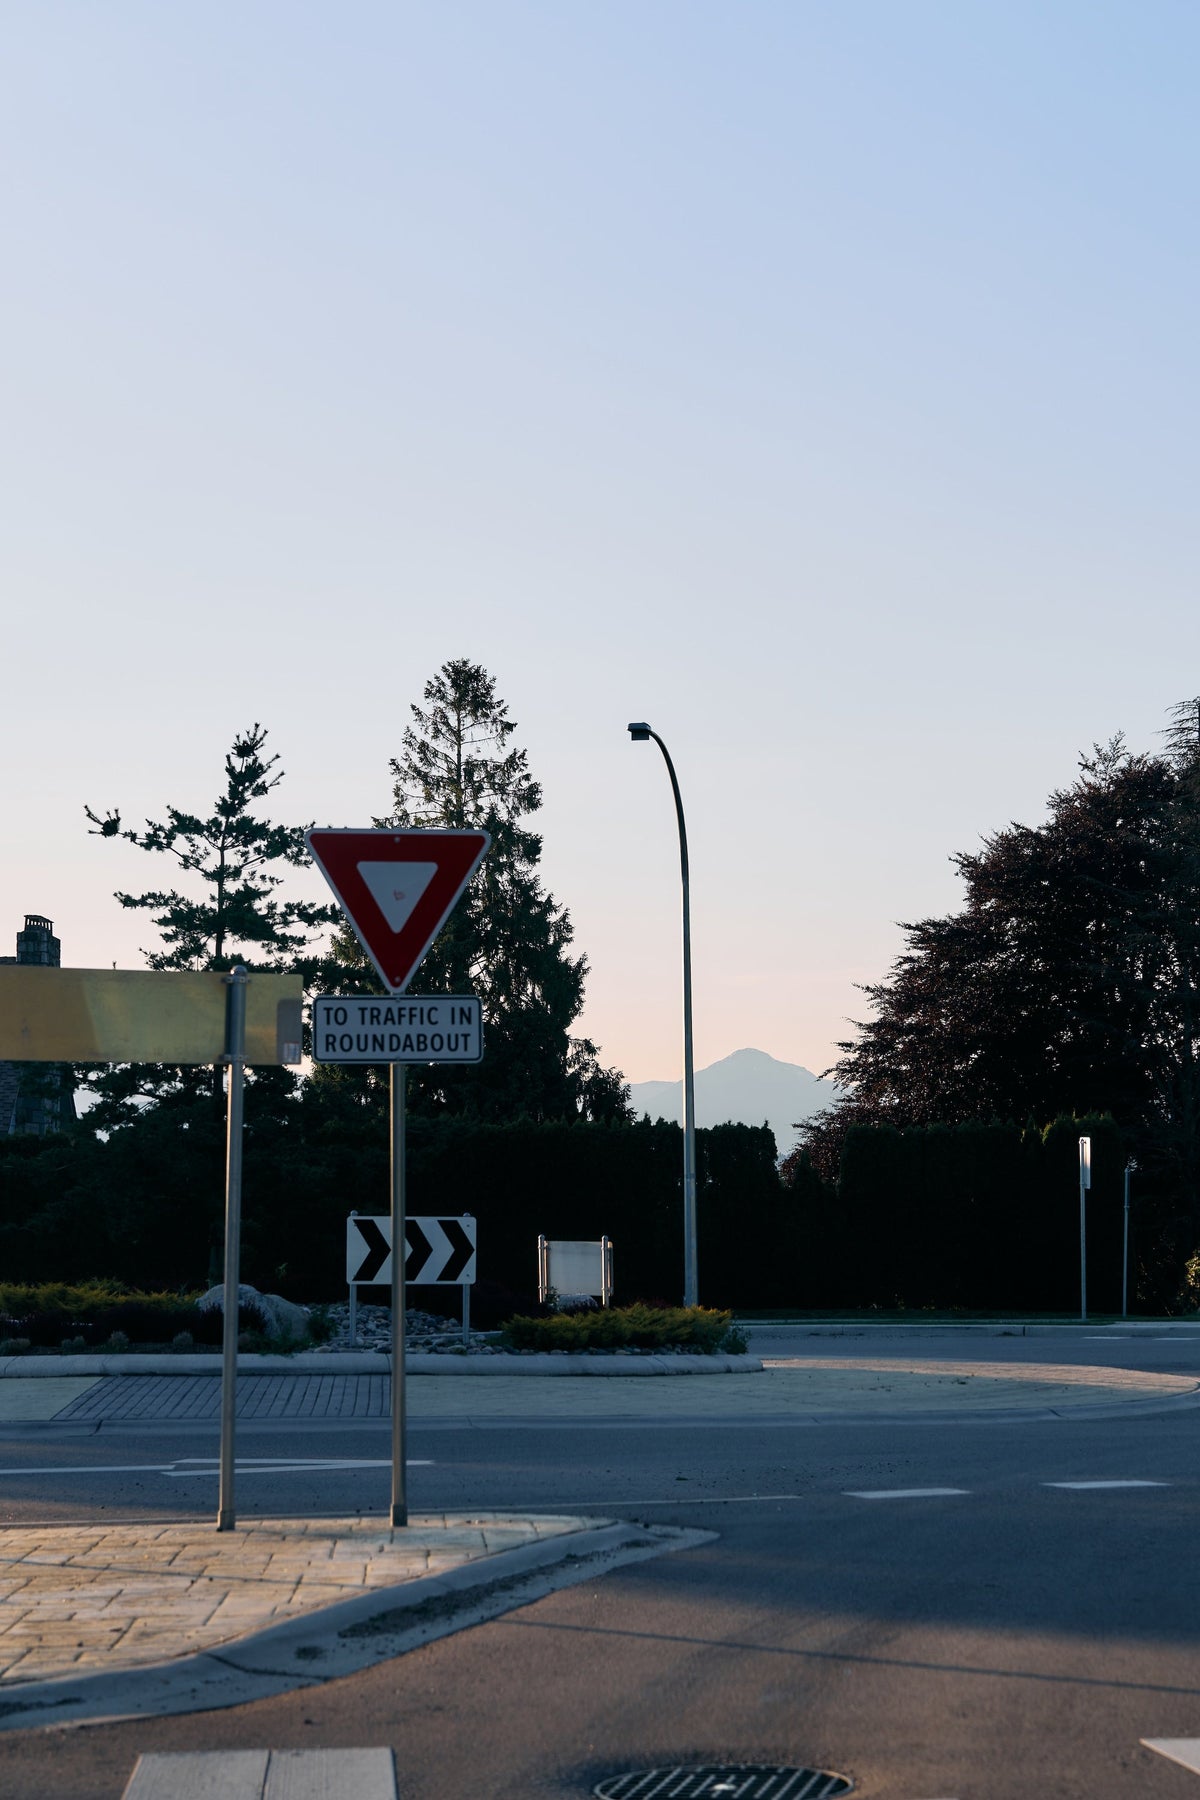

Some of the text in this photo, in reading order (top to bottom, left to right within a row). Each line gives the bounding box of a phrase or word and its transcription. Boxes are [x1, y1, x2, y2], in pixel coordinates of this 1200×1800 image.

[323, 1007, 472, 1026] TO TRAFFIC IN
[325, 1033, 471, 1052] ROUNDABOUT
